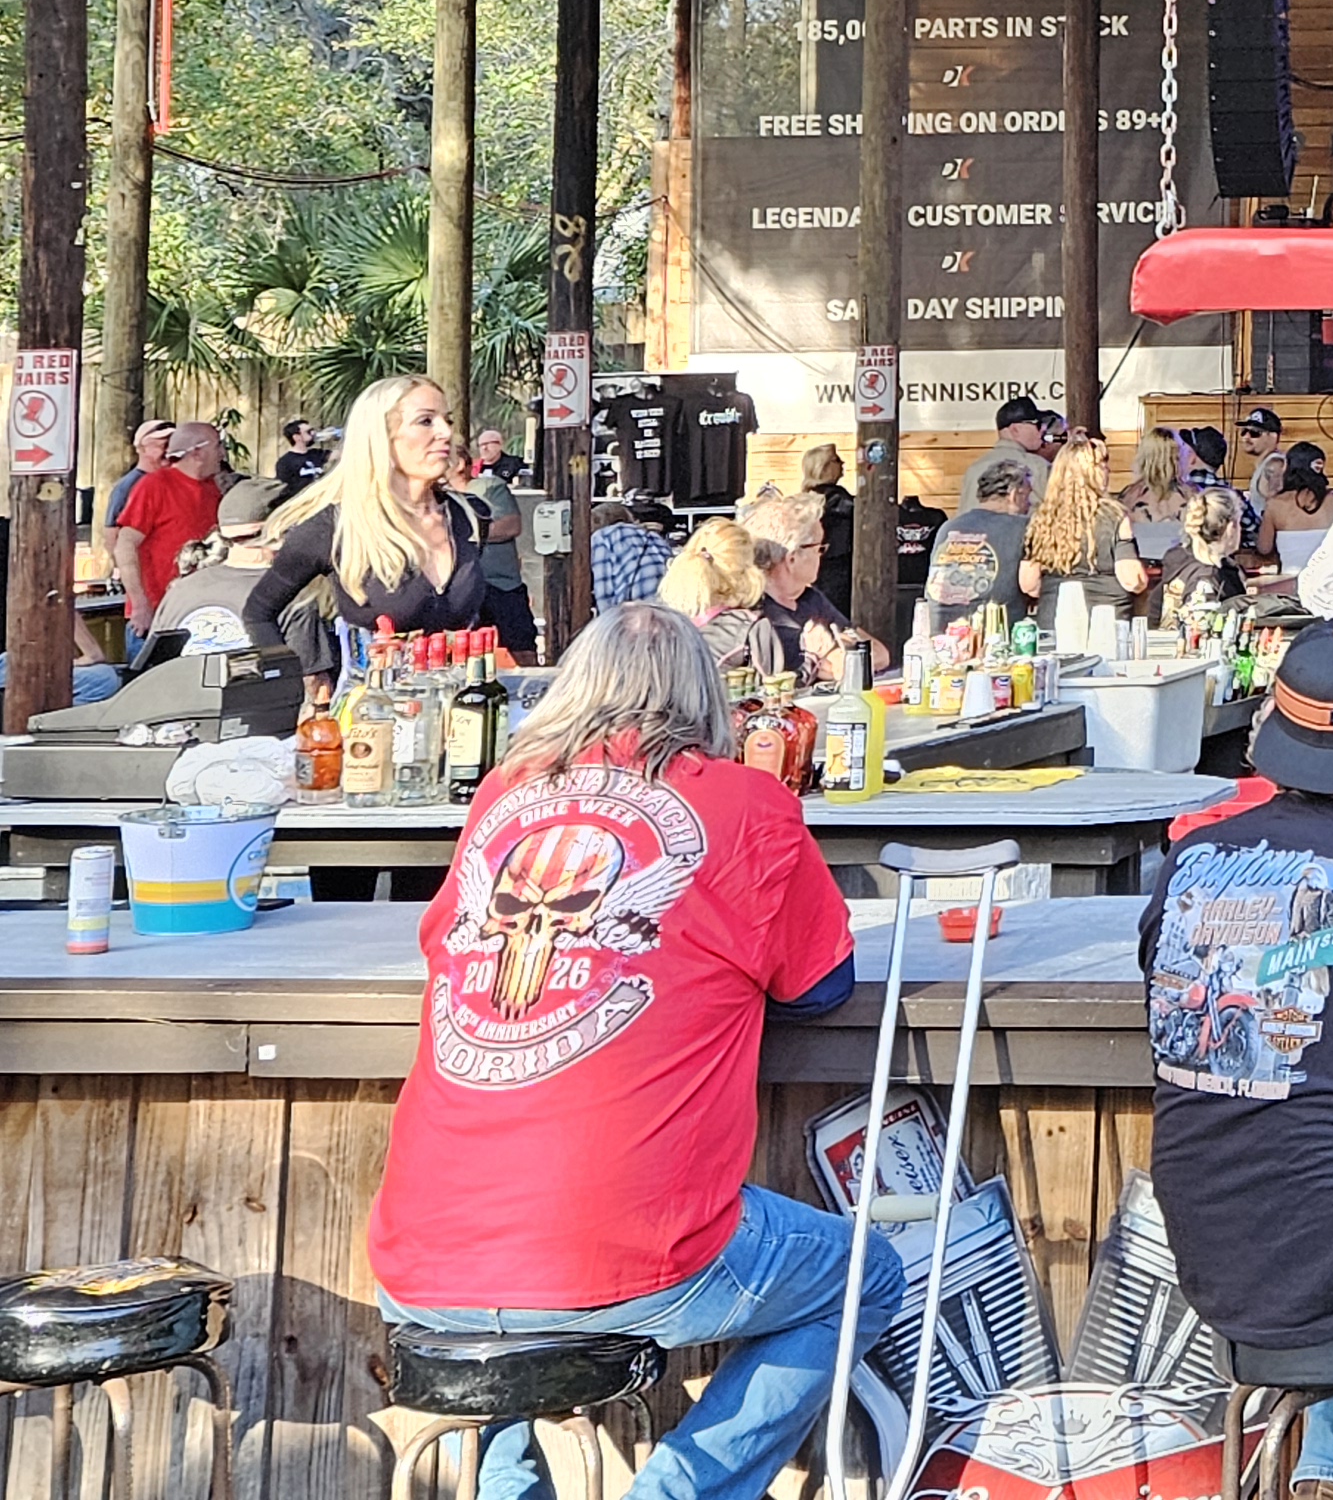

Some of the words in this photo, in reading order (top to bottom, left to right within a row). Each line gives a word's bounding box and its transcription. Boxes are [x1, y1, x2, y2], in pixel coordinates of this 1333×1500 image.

[794, 20, 868, 45] 185,0
[914, 17, 999, 40] PARTS
[1007, 16, 1034, 39] IN
[1040, 15, 1129, 38] STCK
[758, 113, 822, 137] FREE
[828, 110, 953, 136] SHING
[959, 110, 997, 133] ON
[1003, 108, 1108, 133] ORDS
[1115, 108, 1162, 131] 89+
[751, 206, 861, 230] LEGENDA
[907, 202, 1052, 227] CUSTOMER
[1059, 200, 1168, 226] RVICE
[825, 298, 859, 322] SA
[907, 297, 959, 320] DAY
[965, 295, 1066, 319] SHIPPIN
[543, 348, 585, 360] HAIRS
[558, 335, 585, 347] RED
[870, 346, 894, 357] RED
[32, 354, 71, 370] RED
[856, 357, 895, 367] HAIRS
[14, 371, 70, 386] HAIRS
[475, 766, 604, 849] DAYTONA
[613, 773, 698, 849] BEACH
[578, 801, 641, 828] WEEK
[1167, 838, 1314, 899] Daytona
[1201, 895, 1284, 921] HARLEY-
[1188, 920, 1284, 946] DAVIDSON
[1266, 938, 1321, 977] MAIN
[461, 959, 495, 995] 20
[548, 956, 592, 991] 26
[475, 1001, 579, 1041] ANNIVERSARY
